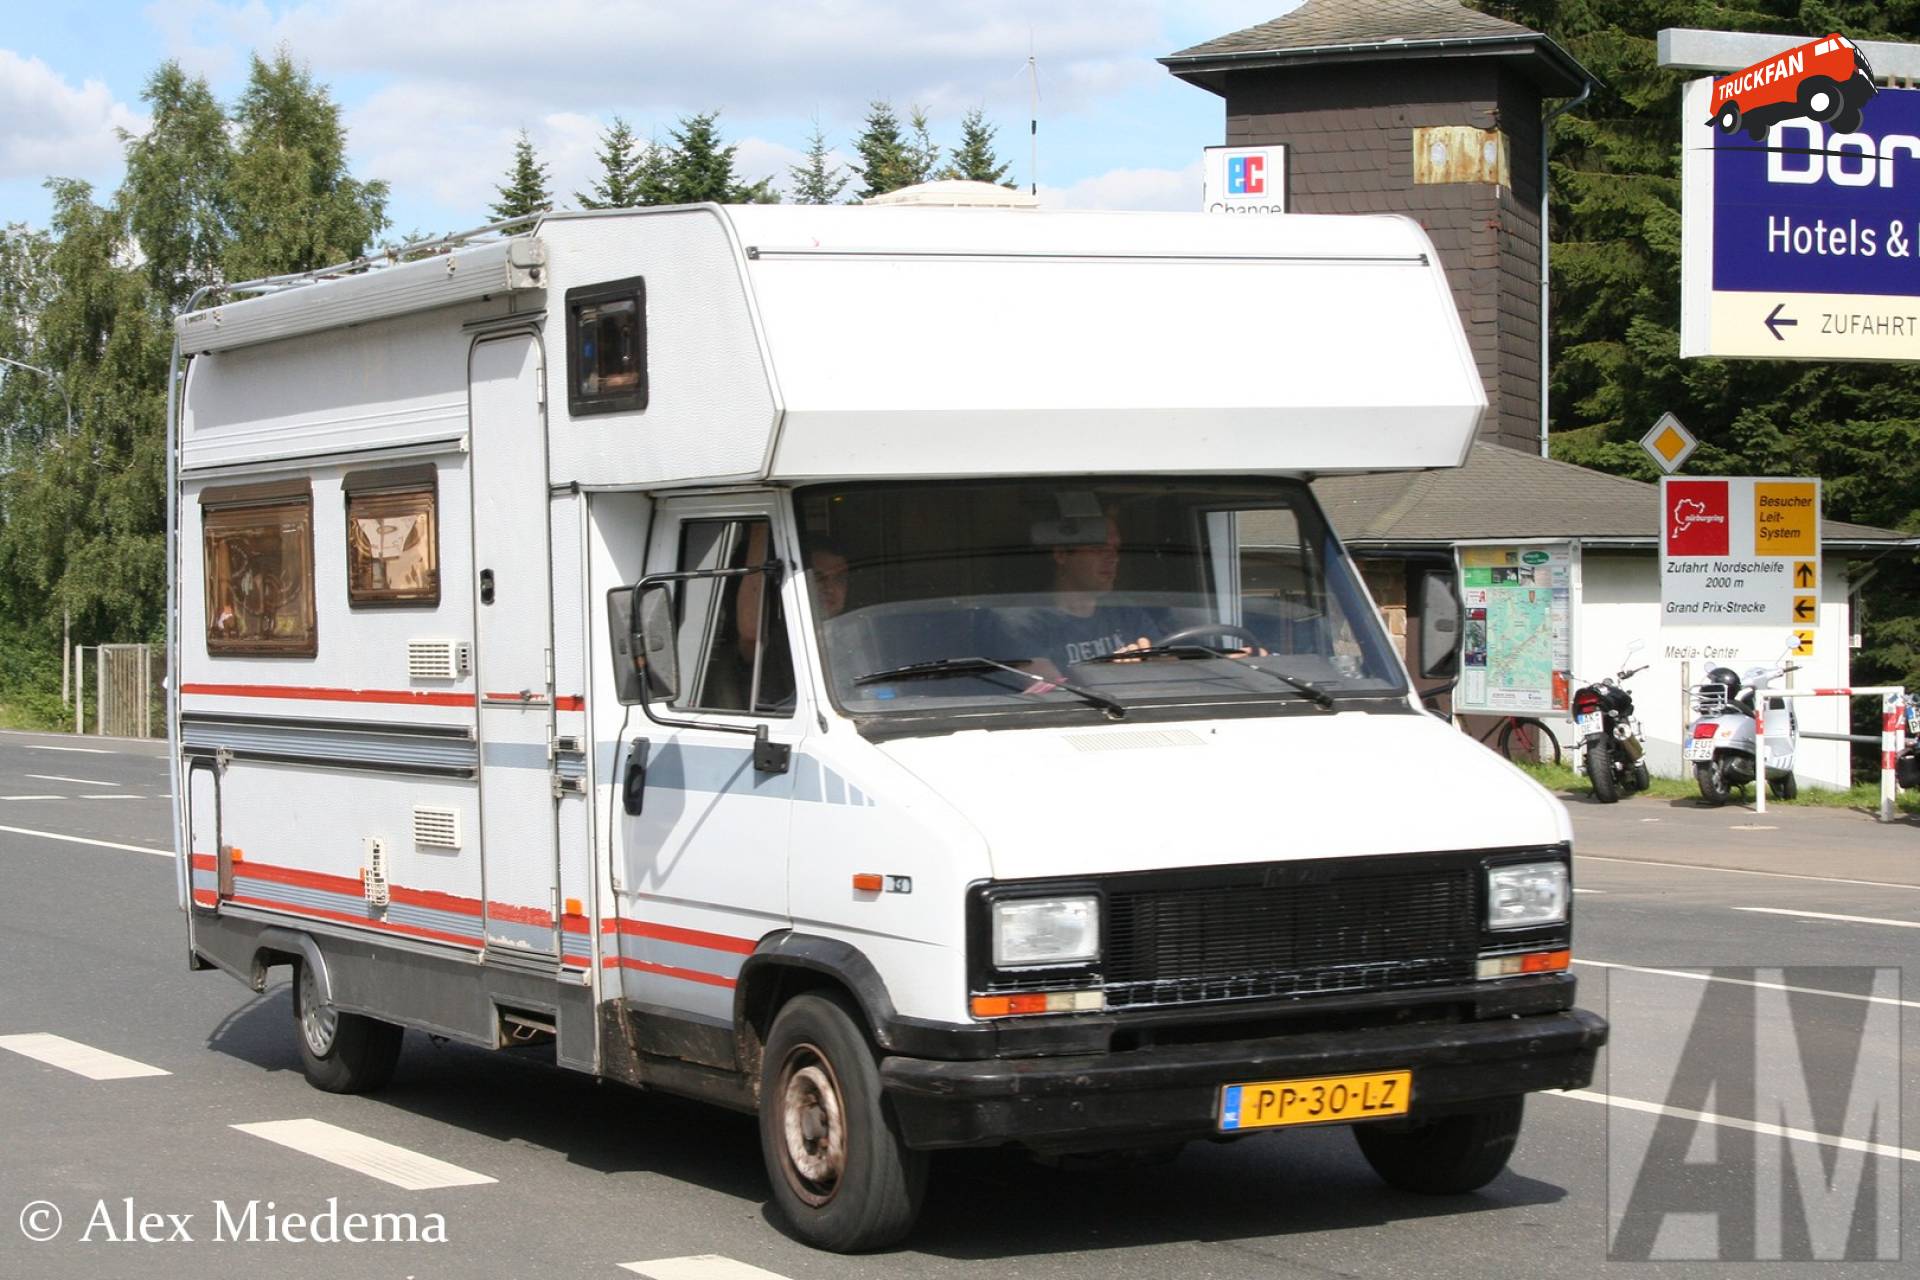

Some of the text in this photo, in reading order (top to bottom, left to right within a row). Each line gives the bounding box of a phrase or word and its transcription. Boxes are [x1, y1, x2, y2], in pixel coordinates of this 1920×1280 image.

[1768, 216, 1910, 257] Hotels &
[1821, 313, 1917, 336] ZUFAHRT
[1759, 496, 1812, 508] Besucher
[1759, 512, 1784, 523] Leit-
[1759, 527, 1801, 540] System
[1666, 561, 1784, 573] Zufahrt Nordschleife
[1705, 577, 1744, 588] 2000 m
[1666, 602, 1766, 613] Grand Prix-Strecke
[1703, 646, 1739, 659] Center
[1256, 1079, 1397, 1120] PP-30-LZ
